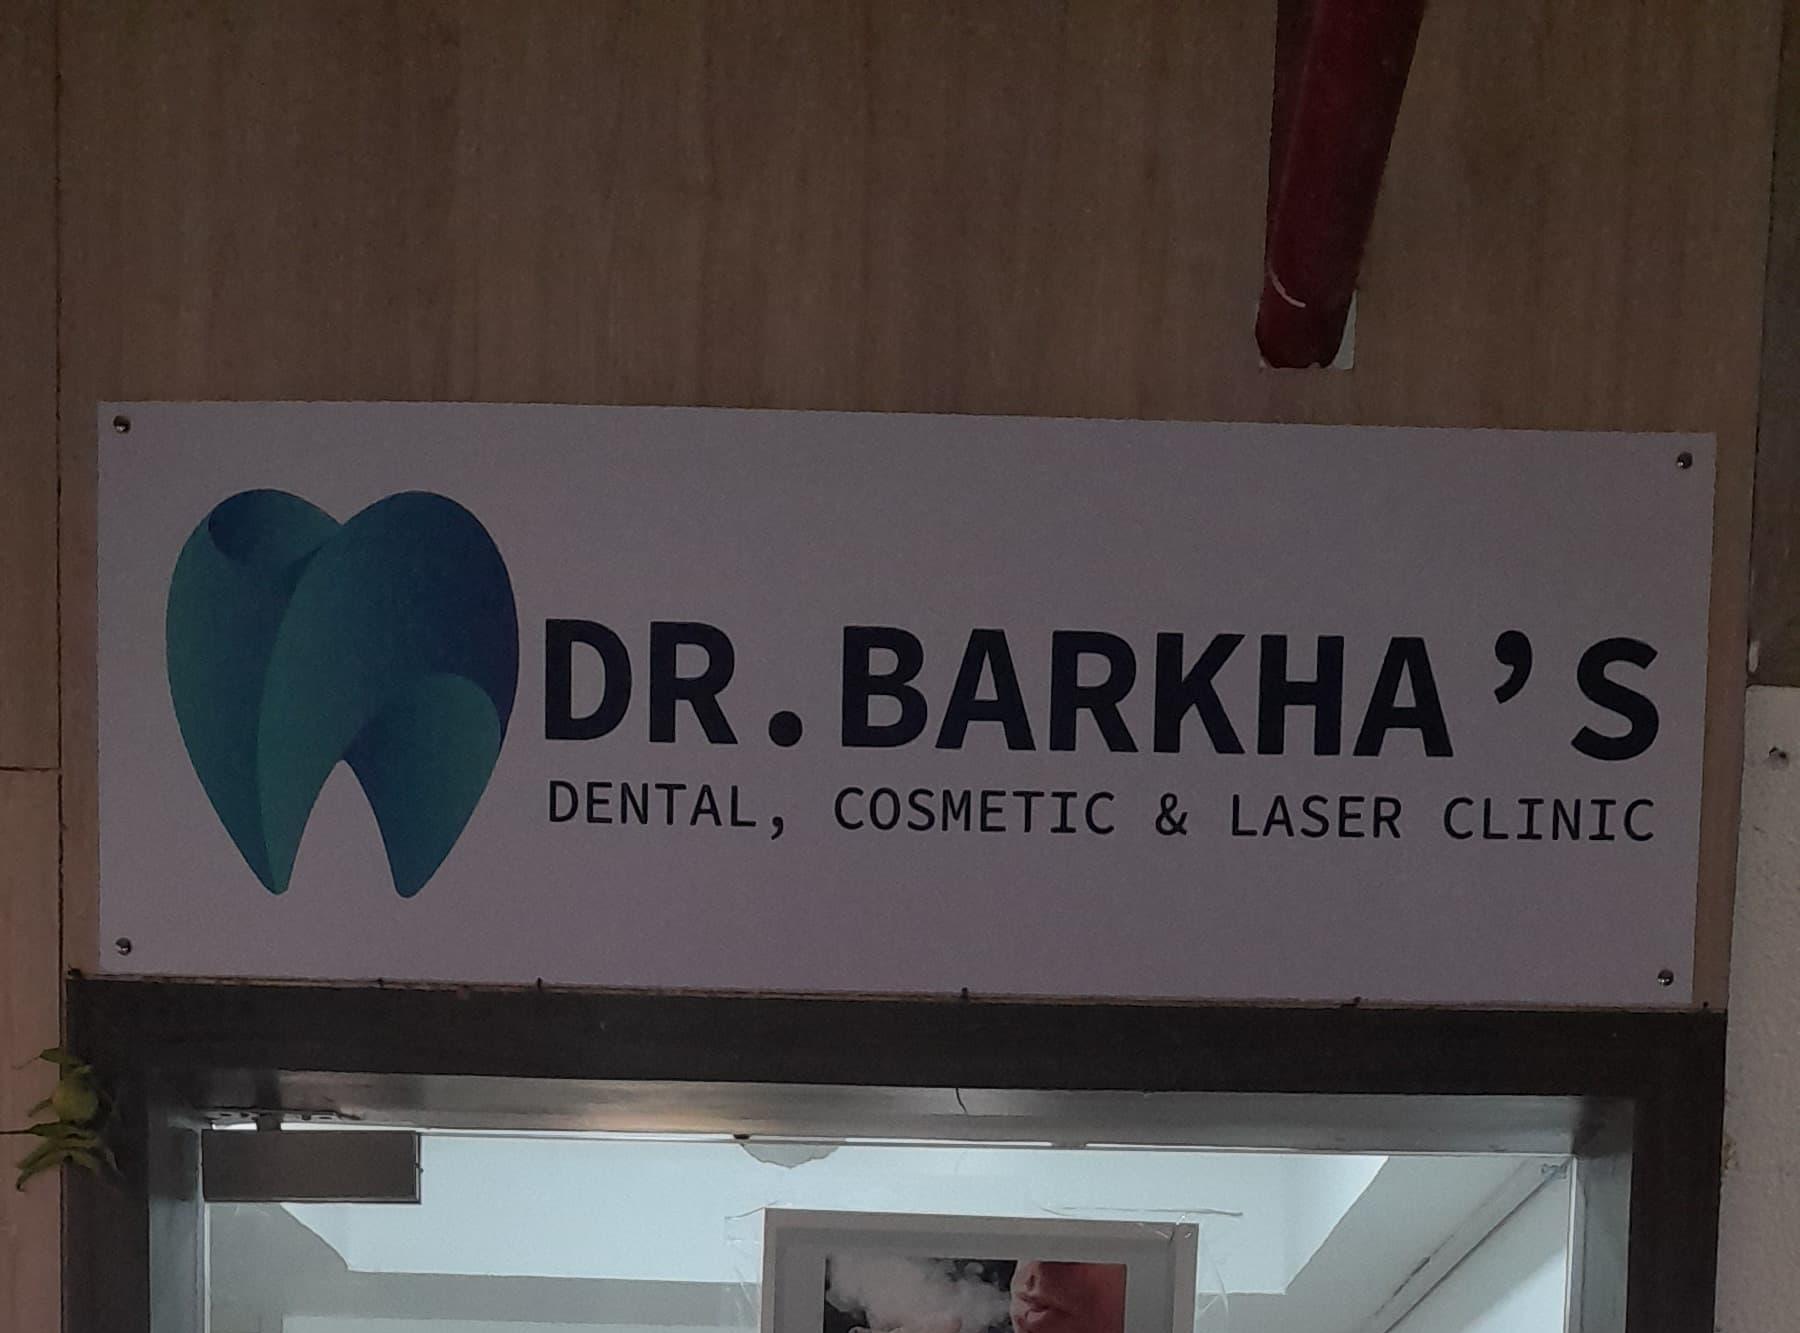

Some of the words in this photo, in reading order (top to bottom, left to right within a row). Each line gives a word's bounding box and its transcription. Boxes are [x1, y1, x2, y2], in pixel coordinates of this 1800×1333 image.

[547, 780, 787, 842] DENTAL,
[833, 786, 1117, 836] COSMETIC
[1155, 793, 1189, 838] &
[1230, 794, 1403, 841] LASER
[1442, 797, 1657, 844] CLINIC
